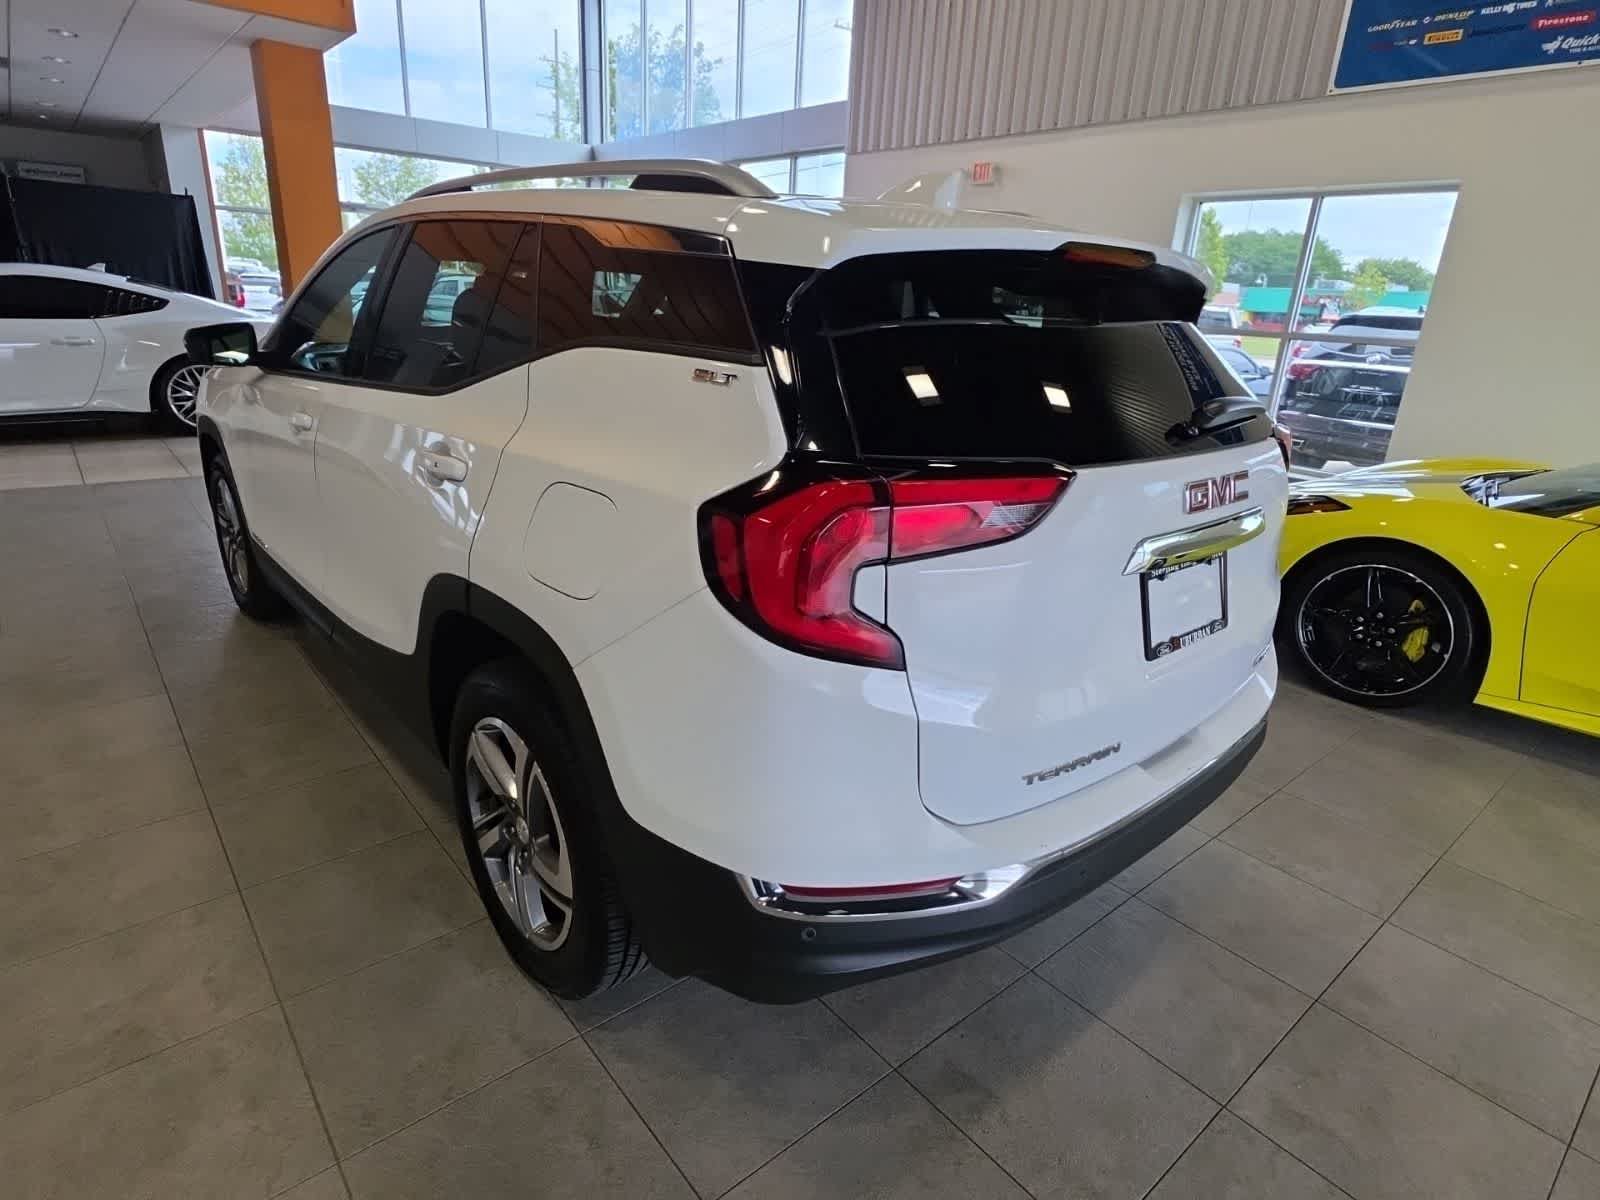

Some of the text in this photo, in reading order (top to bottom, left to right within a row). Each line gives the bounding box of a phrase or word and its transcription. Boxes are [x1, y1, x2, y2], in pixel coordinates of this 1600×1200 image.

[1433, 10, 1475, 21] DUNLOP
[1537, 15, 1590, 28] Firestone
[1367, 19, 1418, 32] GOODYEAR
[1562, 33, 1600, 49] Quick
[973, 163, 993, 181] EXIT
[692, 368, 738, 386] SLT
[1184, 470, 1249, 515] GMC
[1022, 741, 1121, 786] TERRAIN
